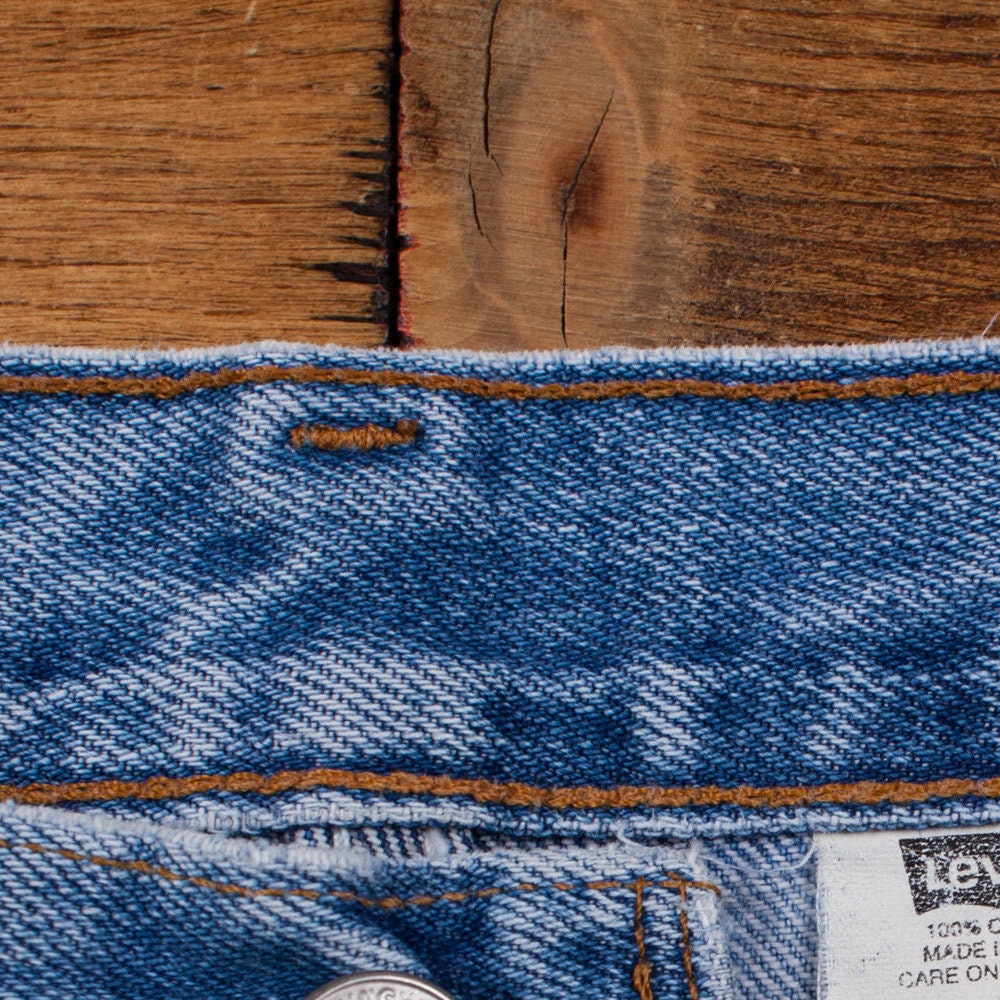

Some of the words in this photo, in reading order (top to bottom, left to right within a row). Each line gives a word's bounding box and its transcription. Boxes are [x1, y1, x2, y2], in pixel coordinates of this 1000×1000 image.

[928, 920, 982, 938] 100%
[923, 939, 987, 962] MADE
[899, 967, 960, 988] CARE
[966, 964, 999, 982] ON
